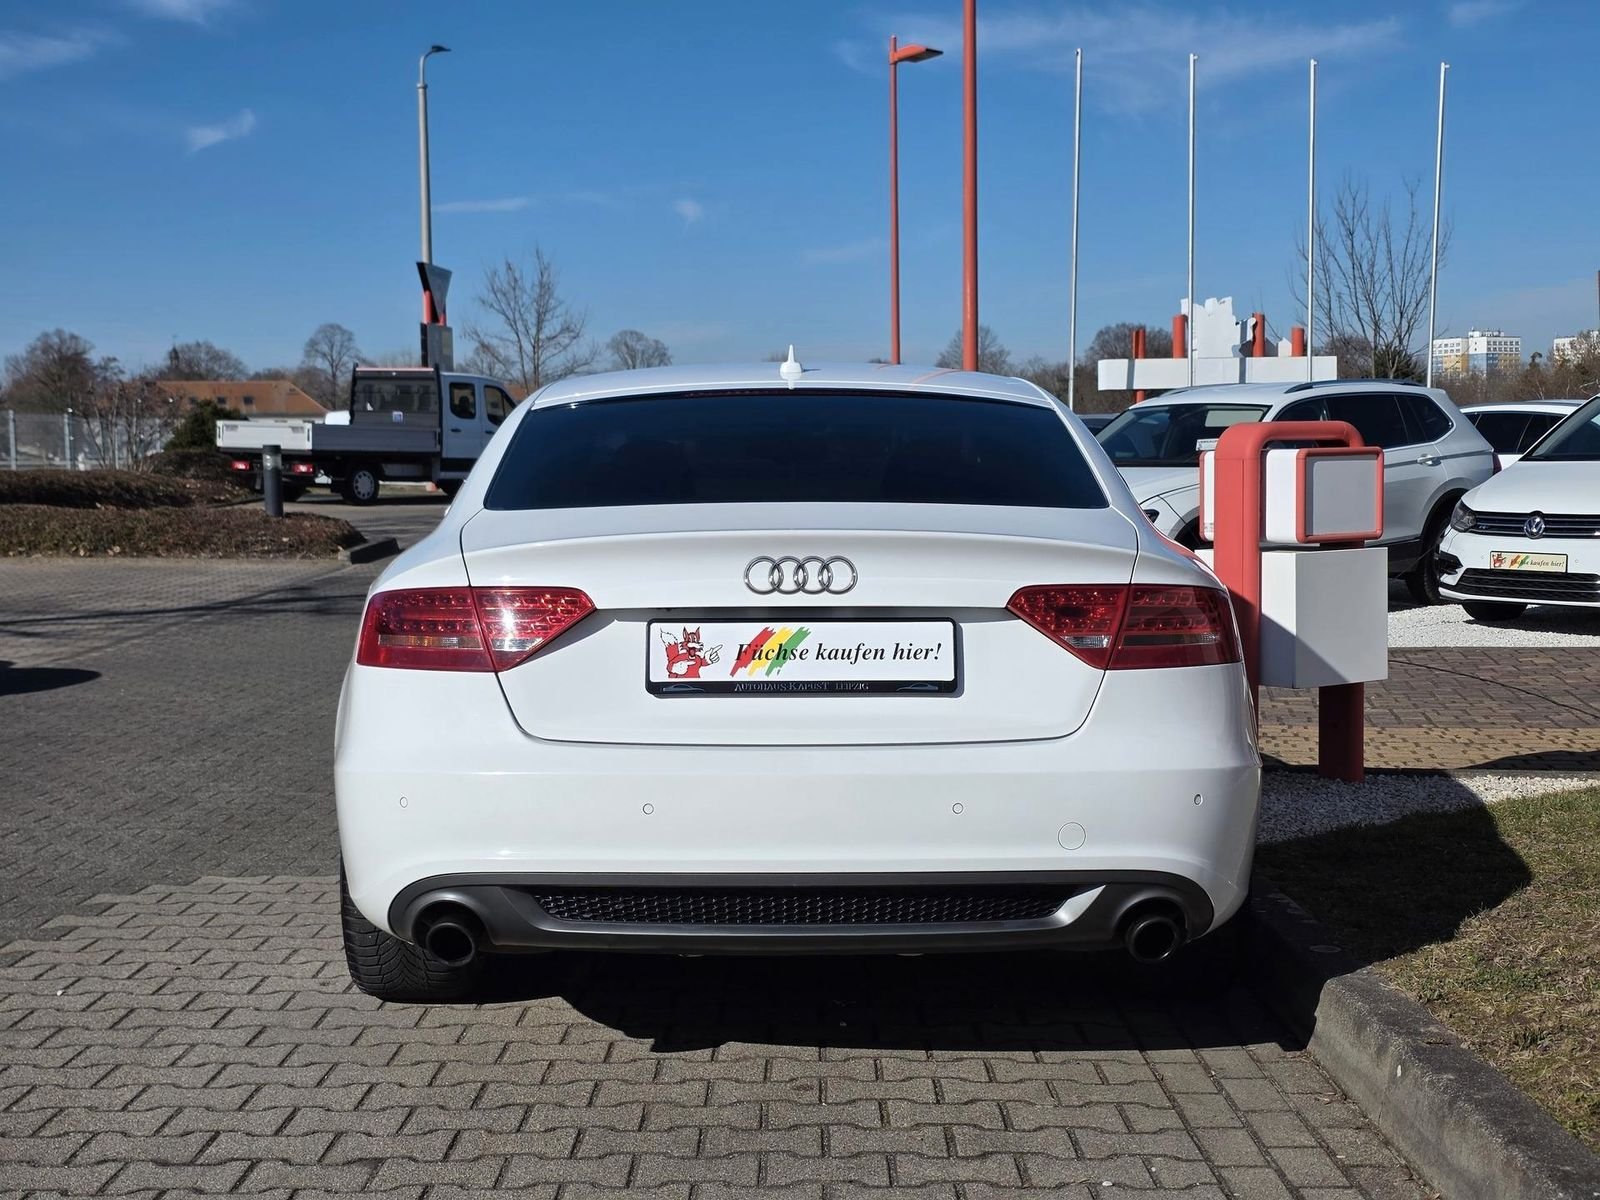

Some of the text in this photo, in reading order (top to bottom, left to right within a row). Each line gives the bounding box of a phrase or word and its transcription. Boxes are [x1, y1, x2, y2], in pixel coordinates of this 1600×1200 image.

[1530, 559, 1549, 567] kaufen
[735, 642, 942, 664] Füchse kaufen hier!
[734, 682, 869, 692] AUTOHAUS KAPUST LEIPZIG
